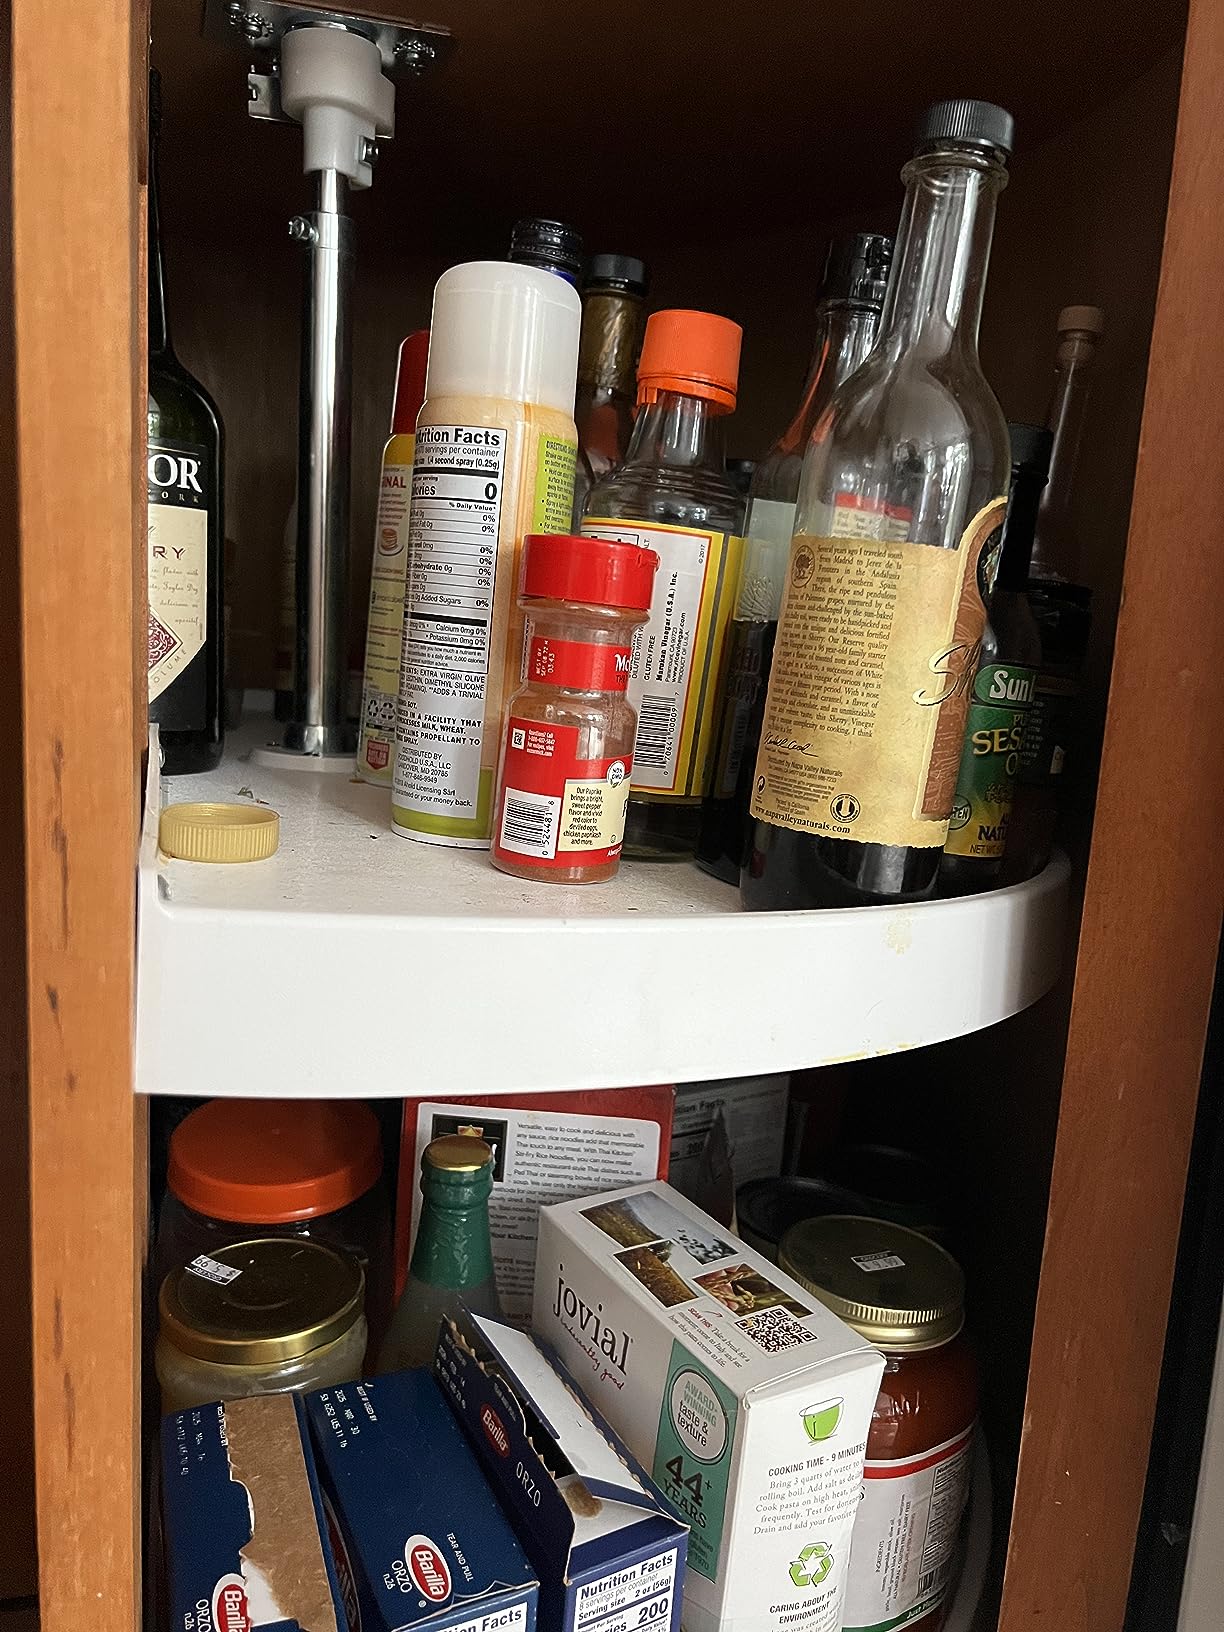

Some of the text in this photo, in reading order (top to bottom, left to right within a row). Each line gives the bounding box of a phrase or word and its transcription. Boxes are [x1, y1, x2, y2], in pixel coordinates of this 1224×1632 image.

[454, 428, 500, 446] Facts
[449, 447, 499, 457] per container
[434, 456, 500, 470] second spray (0.25g)
[148, 454, 202, 493] OR
[161, 491, 199, 503] ORK
[484, 482, 498, 500] 0
[456, 502, 472, 510] Daily
[482, 514, 496, 523] 0%
[482, 525, 495, 534] 0%
[153, 545, 186, 560] RY
[480, 546, 493, 555] 0%
[863, 548, 886, 558] traveled
[479, 557, 492, 566] 0%
[833, 557, 853, 565] Madrid
[478, 568, 491, 576] 0%
[871, 570, 900, 580] Andalusia
[477, 578, 491, 587] 0%
[847, 577, 874, 588] southern
[421, 593, 489, 608] Added Sugars 0%
[866, 590, 897, 600] pendulous
[847, 598, 873, 607] nurtured
[863, 610, 894, 620] sun-baked
[435, 623, 459, 633] Calcium
[656, 571, 678, 682] Marukan Vinegar Inc.
[847, 617, 880, 629] handpicked
[429, 633, 459, 643] Potassium
[840, 627, 890, 641] delicious fortified
[671, 612, 686, 683] www.ricevinegar.com
[828, 634, 889, 651] Our Reserve quality
[644, 635, 656, 681] GLUTEN FREE
[825, 646, 887, 660] year-old family starter
[826, 666, 883, 680] succession White
[860, 662, 885, 671] caramel,
[420, 668, 438, 678] EXTRA
[440, 672, 462, 682] VIRGIN
[464, 675, 485, 683] OLIVE
[813, 674, 875, 690] vinegar various ages
[455, 682, 484, 691] SILICONE
[844, 687, 860, 698] With
[459, 690, 484, 700] TRIVIAL
[852, 698, 869, 708] flavor
[839, 707, 876, 719] unmistakable
[421, 722, 466, 734] MILK, WHEAT.
[424, 714, 482, 728] FACILITY THAT
[829, 714, 875, 728] Sherry Vinegar
[420, 731, 481, 746] PROPELLANT TO
[826, 725, 873, 739] cooking, think
[402, 747, 432, 759] DISTRIBUTED
[664, 736, 673, 761] 70641
[438, 762, 452, 770] LLC
[804, 764, 820, 774] Valley
[820, 768, 843, 778] Naturals
[416, 783, 442, 796] Licensing
[585, 788, 602, 796] Paprika
[433, 797, 473, 807] money back.
[570, 794, 585, 802] brings
[568, 808, 582, 816] flavor
[755, 805, 851, 834] www.napavalleynaturals.com
[595, 1129, 621, 1137] delicious
[553, 1263, 634, 1376] jovial
[684, 1380, 718, 1412] AWARD-
[683, 1389, 717, 1427] WINNING
[679, 1400, 709, 1435] taste &
[482, 1409, 509, 1451] Barilla
[677, 1413, 707, 1447] texture
[768, 1441, 866, 1477] COOKING TIME 9 MINUTES
[516, 1461, 541, 1507] ORZO
[769, 1464, 852, 1490] Bring quarts of water
[759, 1479, 837, 1502] rolling boil. Add salt
[663, 1477, 707, 1529] YEARS
[755, 1489, 848, 1513] Cook pasta high heat,
[760, 1503, 835, 1524] frequently. Test for
[753, 1510, 852, 1535] Drain and add your favorite
[446, 1532, 474, 1582] TEAR AND PULL
[391, 1560, 413, 1593] ORZO
[414, 1549, 446, 1596] Barilla
[580, 1554, 673, 1600] Nutrition Facts
[382, 1573, 396, 1590] n.26
[578, 1575, 672, 1621] Serving size oz (56g)
[585, 1573, 659, 1609] servings per container
[769, 1593, 826, 1614] CARING ABOUT
[637, 1598, 669, 1625] 200
[778, 1600, 830, 1624] ENVIRONMENT
[184, 1612, 195, 1631] n.26
[481, 1609, 522, 1632] Facts
